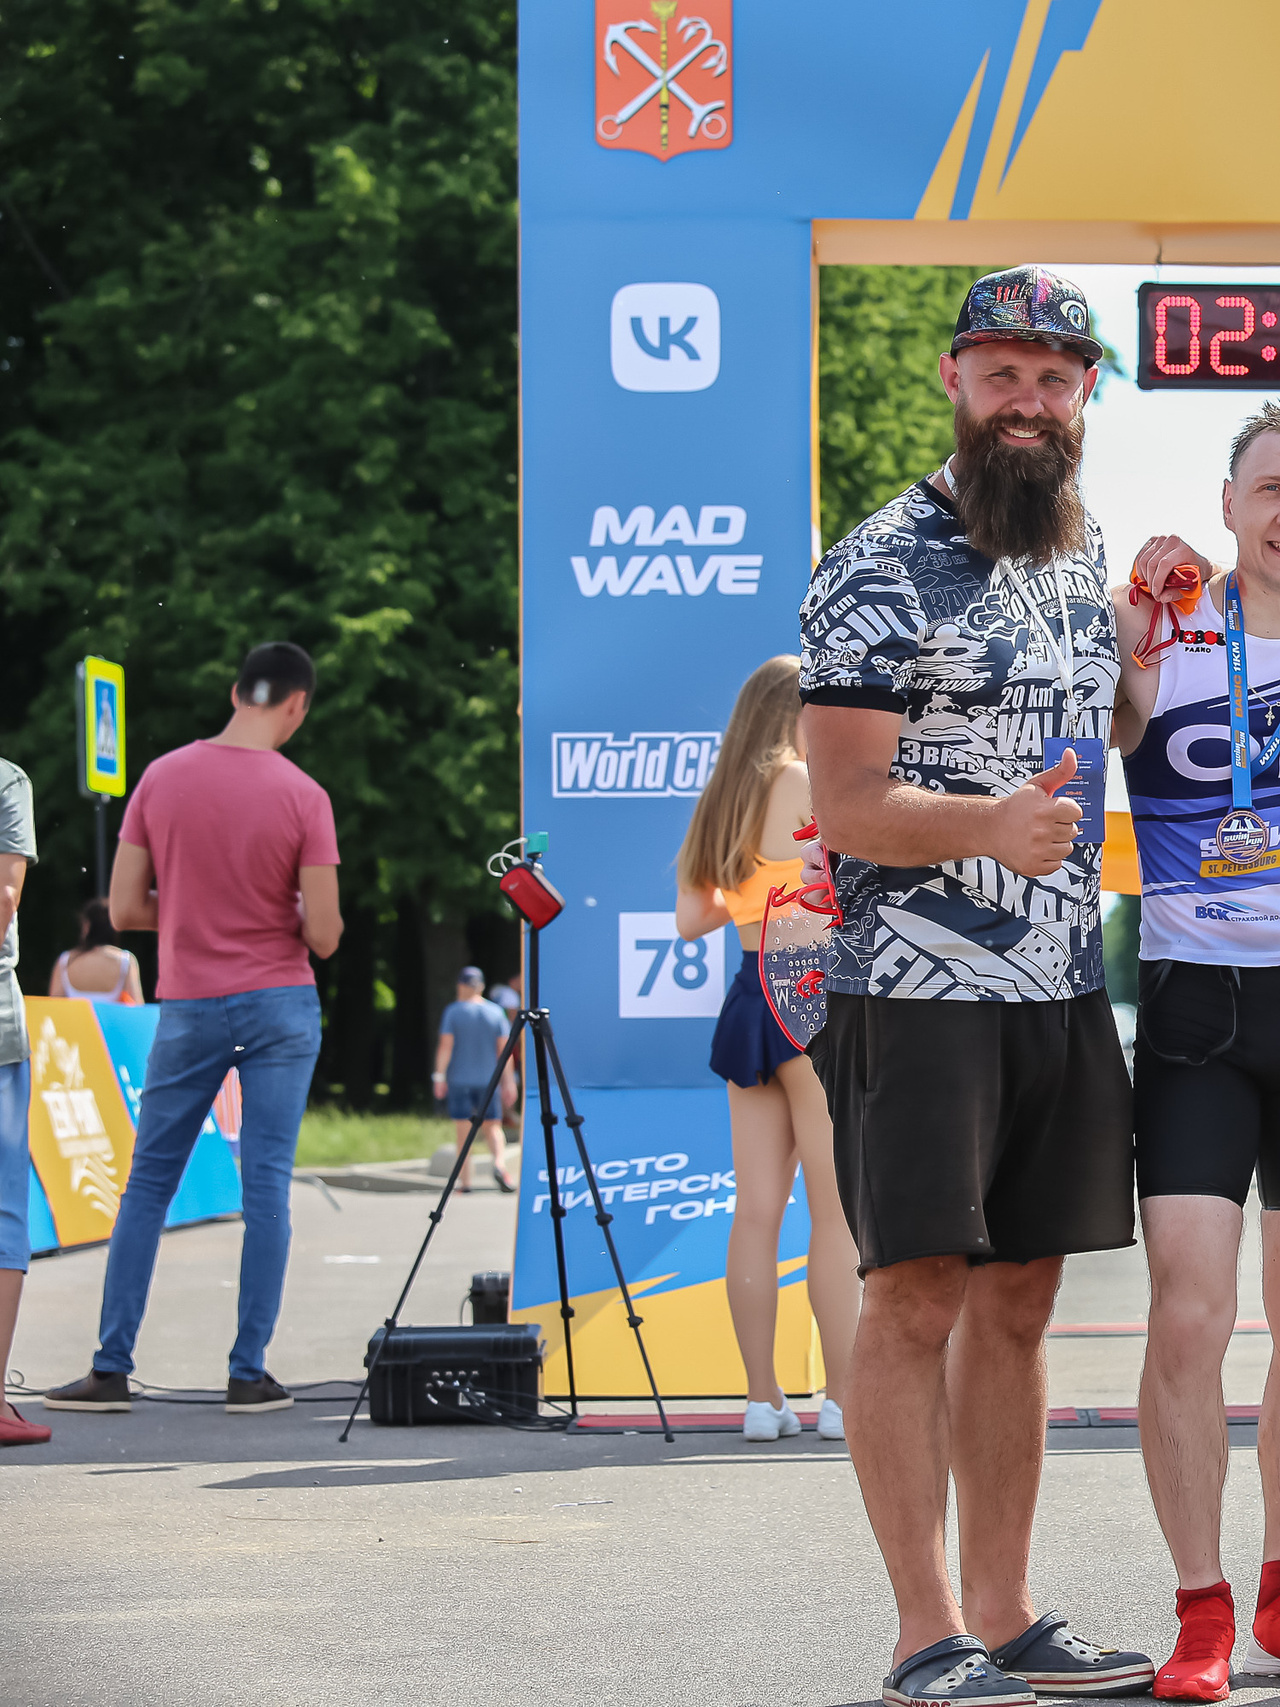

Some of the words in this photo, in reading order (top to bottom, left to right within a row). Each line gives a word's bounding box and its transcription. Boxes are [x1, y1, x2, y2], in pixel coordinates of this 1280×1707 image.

[630, 316, 701, 361] VK
[588, 504, 748, 547] MAD
[570, 554, 764, 598] WAVE
[810, 612, 831, 638] 27
[1232, 641, 1242, 673] 11KM
[1000, 685, 1026, 711] 20
[1027, 684, 1054, 708] km
[1233, 674, 1244, 718] BASIC
[560, 740, 670, 790] World
[1208, 863, 1220, 875] ST.
[1231, 914, 1269, 922] СТРАХОВОЙ
[634, 938, 710, 998] 78
[537, 1152, 690, 1185] ЧИСТО
